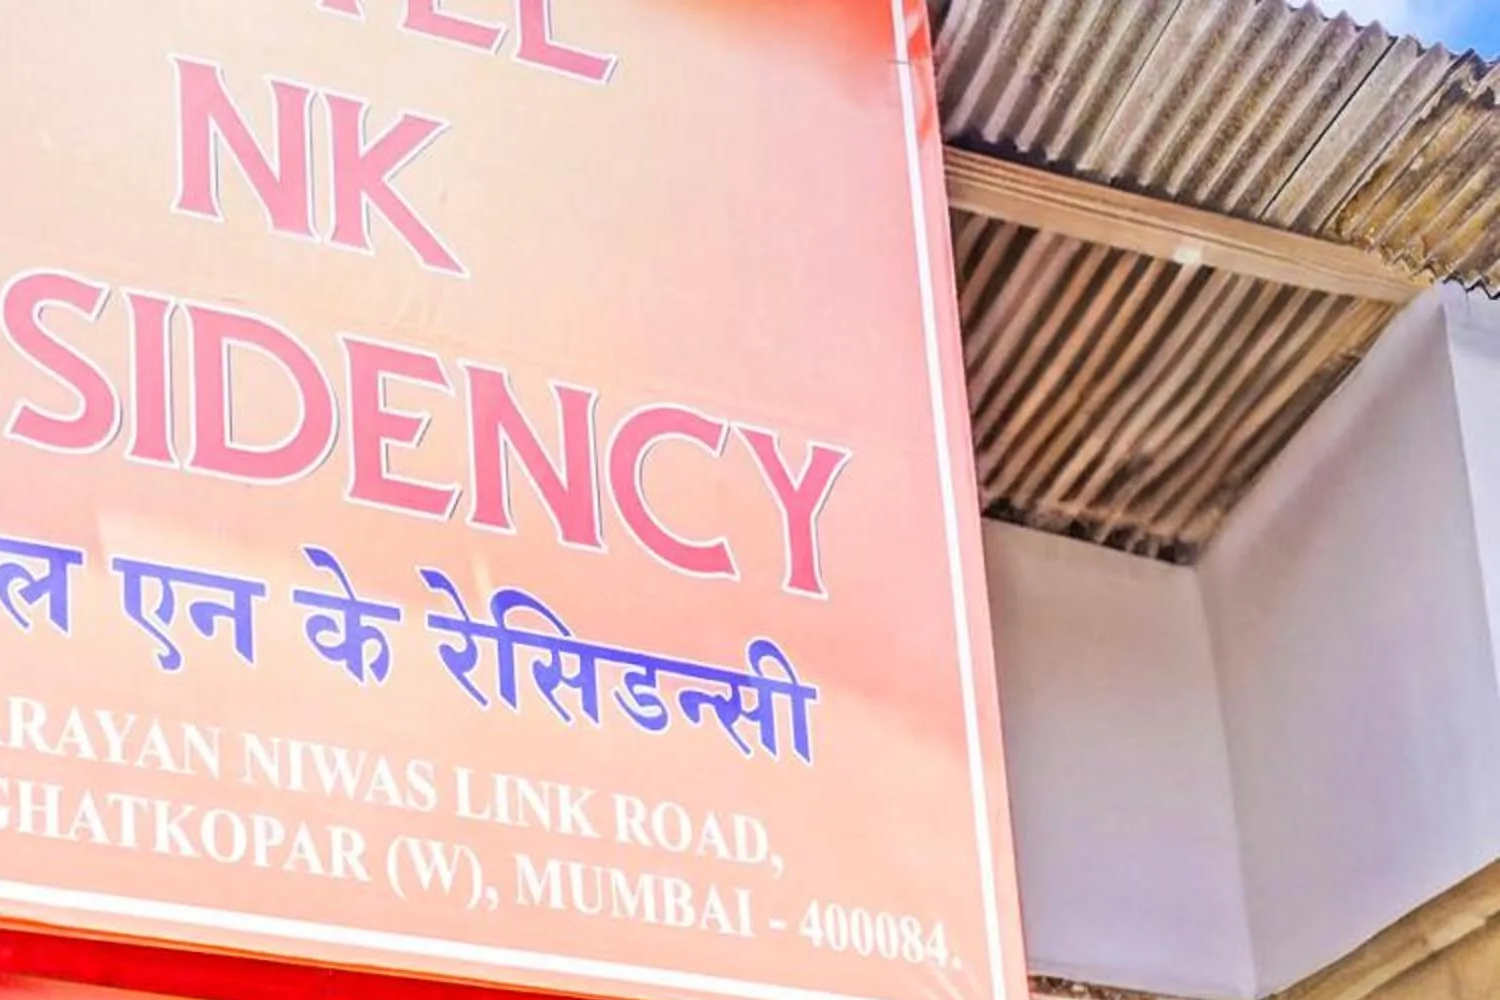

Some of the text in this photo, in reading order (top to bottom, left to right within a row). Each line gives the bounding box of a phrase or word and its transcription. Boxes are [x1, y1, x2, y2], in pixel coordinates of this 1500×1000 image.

[167, 53, 470, 279] NK
[111, 555, 268, 672] एन
[291, 544, 402, 685] के
[422, 566, 820, 764] रेसिडन्सी
[241, 732, 438, 813] NIWAS
[453, 765, 600, 838] LINK
[613, 793, 785, 876] ROAD,
[386, 834, 500, 912] (W),
[514, 852, 756, 938] MUMBAI
[799, 898, 963, 970] 400084.
